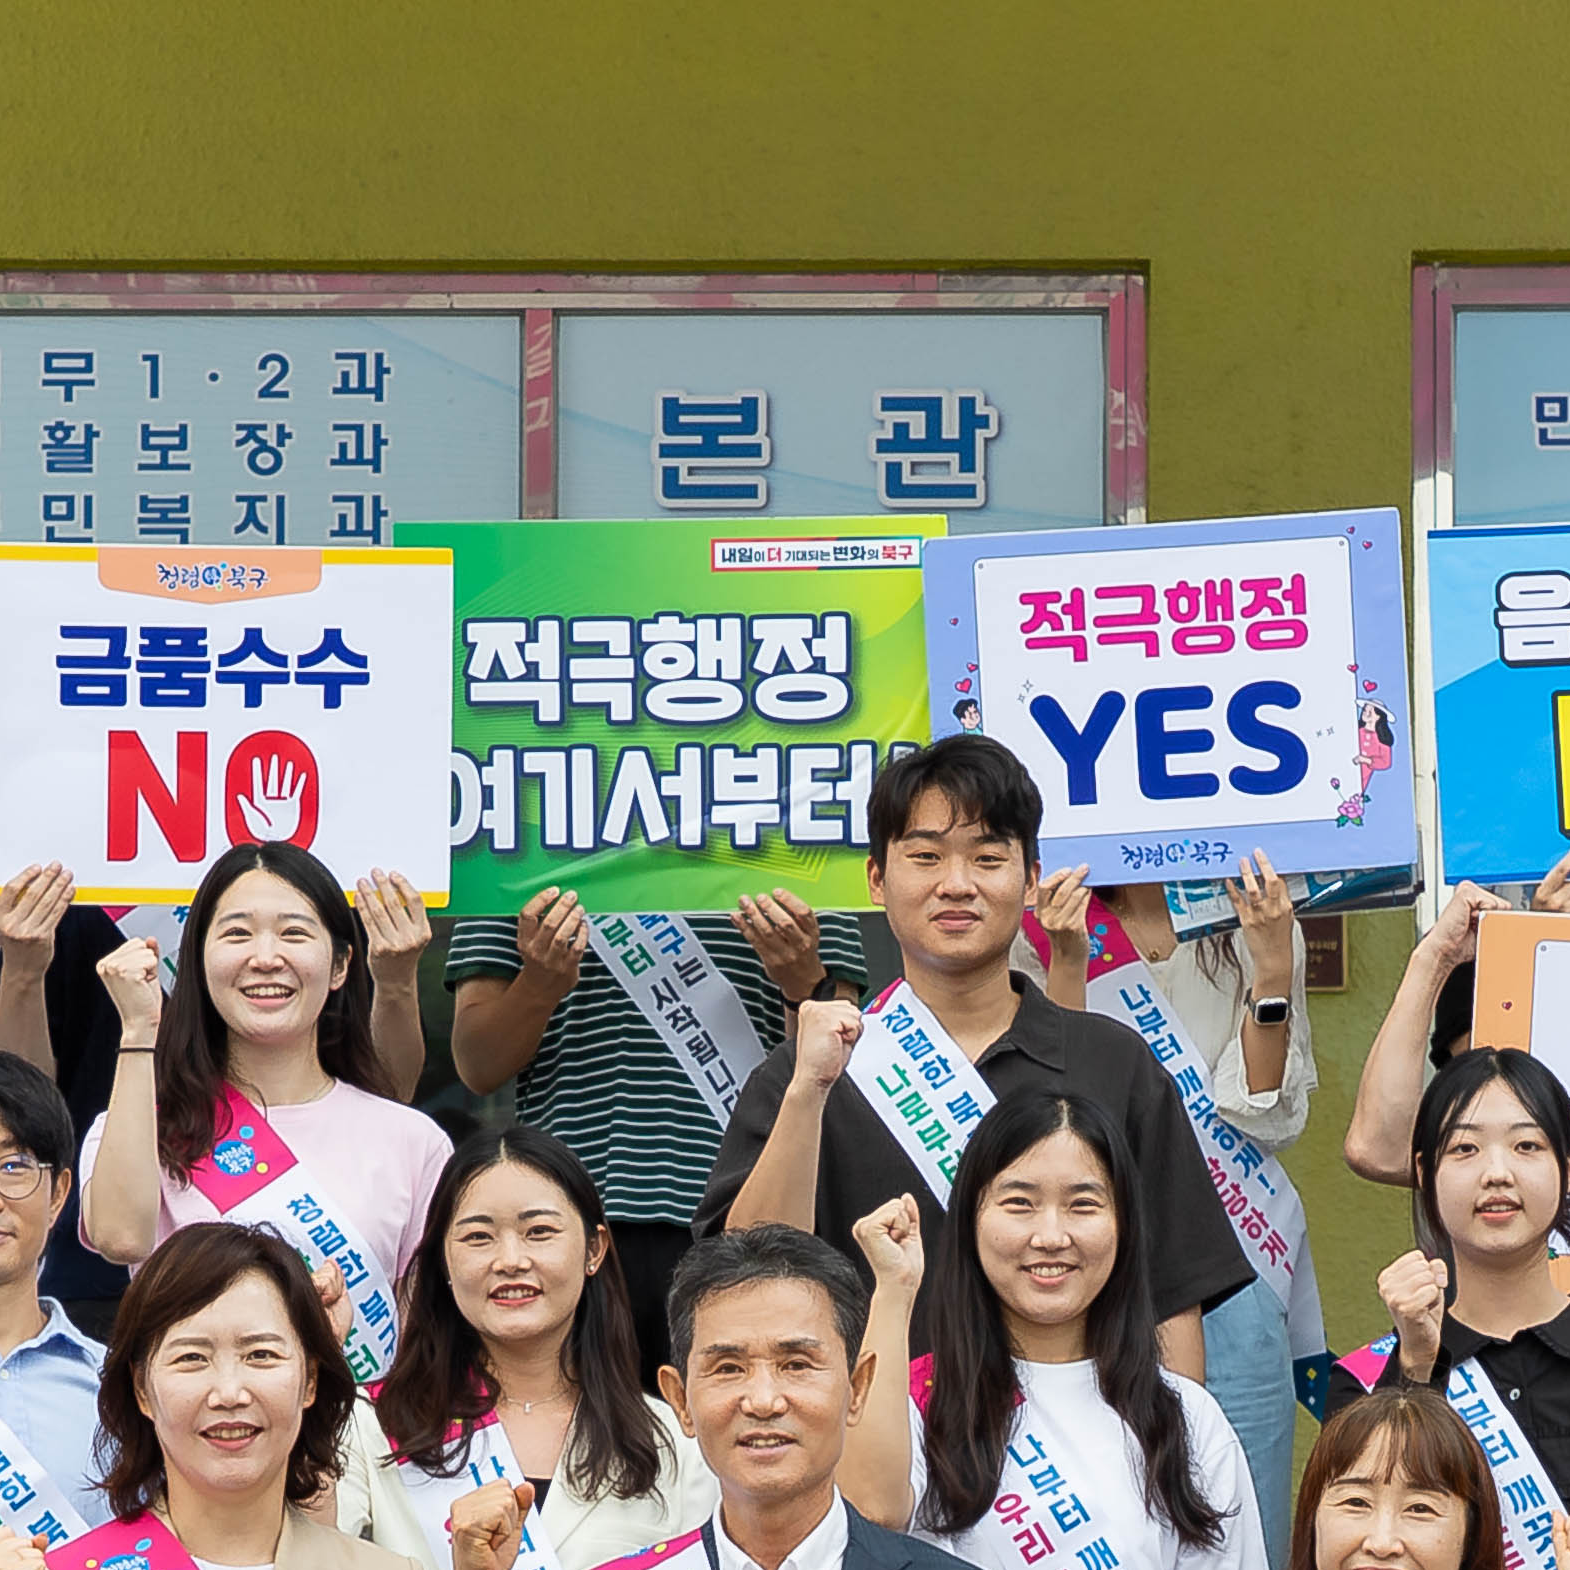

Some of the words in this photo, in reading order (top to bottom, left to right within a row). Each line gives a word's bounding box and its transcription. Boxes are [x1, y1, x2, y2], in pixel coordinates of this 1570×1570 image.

[56, 626, 369, 709] 금품수수
[1021, 573, 1308, 662] 적극행정
[466, 616, 850, 723] 적극행정
[1029, 681, 1310, 806] YES
[107, 730, 318, 863] NO
[450, 744, 871, 848] 여기서부터
[881, 1004, 955, 1088] 청렴한
[1120, 983, 1184, 1063] 나부터
[1174, 1064, 1278, 1196] 깨끗하게!
[286, 1193, 370, 1291] 청렴한
[994, 1493, 1056, 1566] 우리
[1008, 1433, 1093, 1534] 나부터
